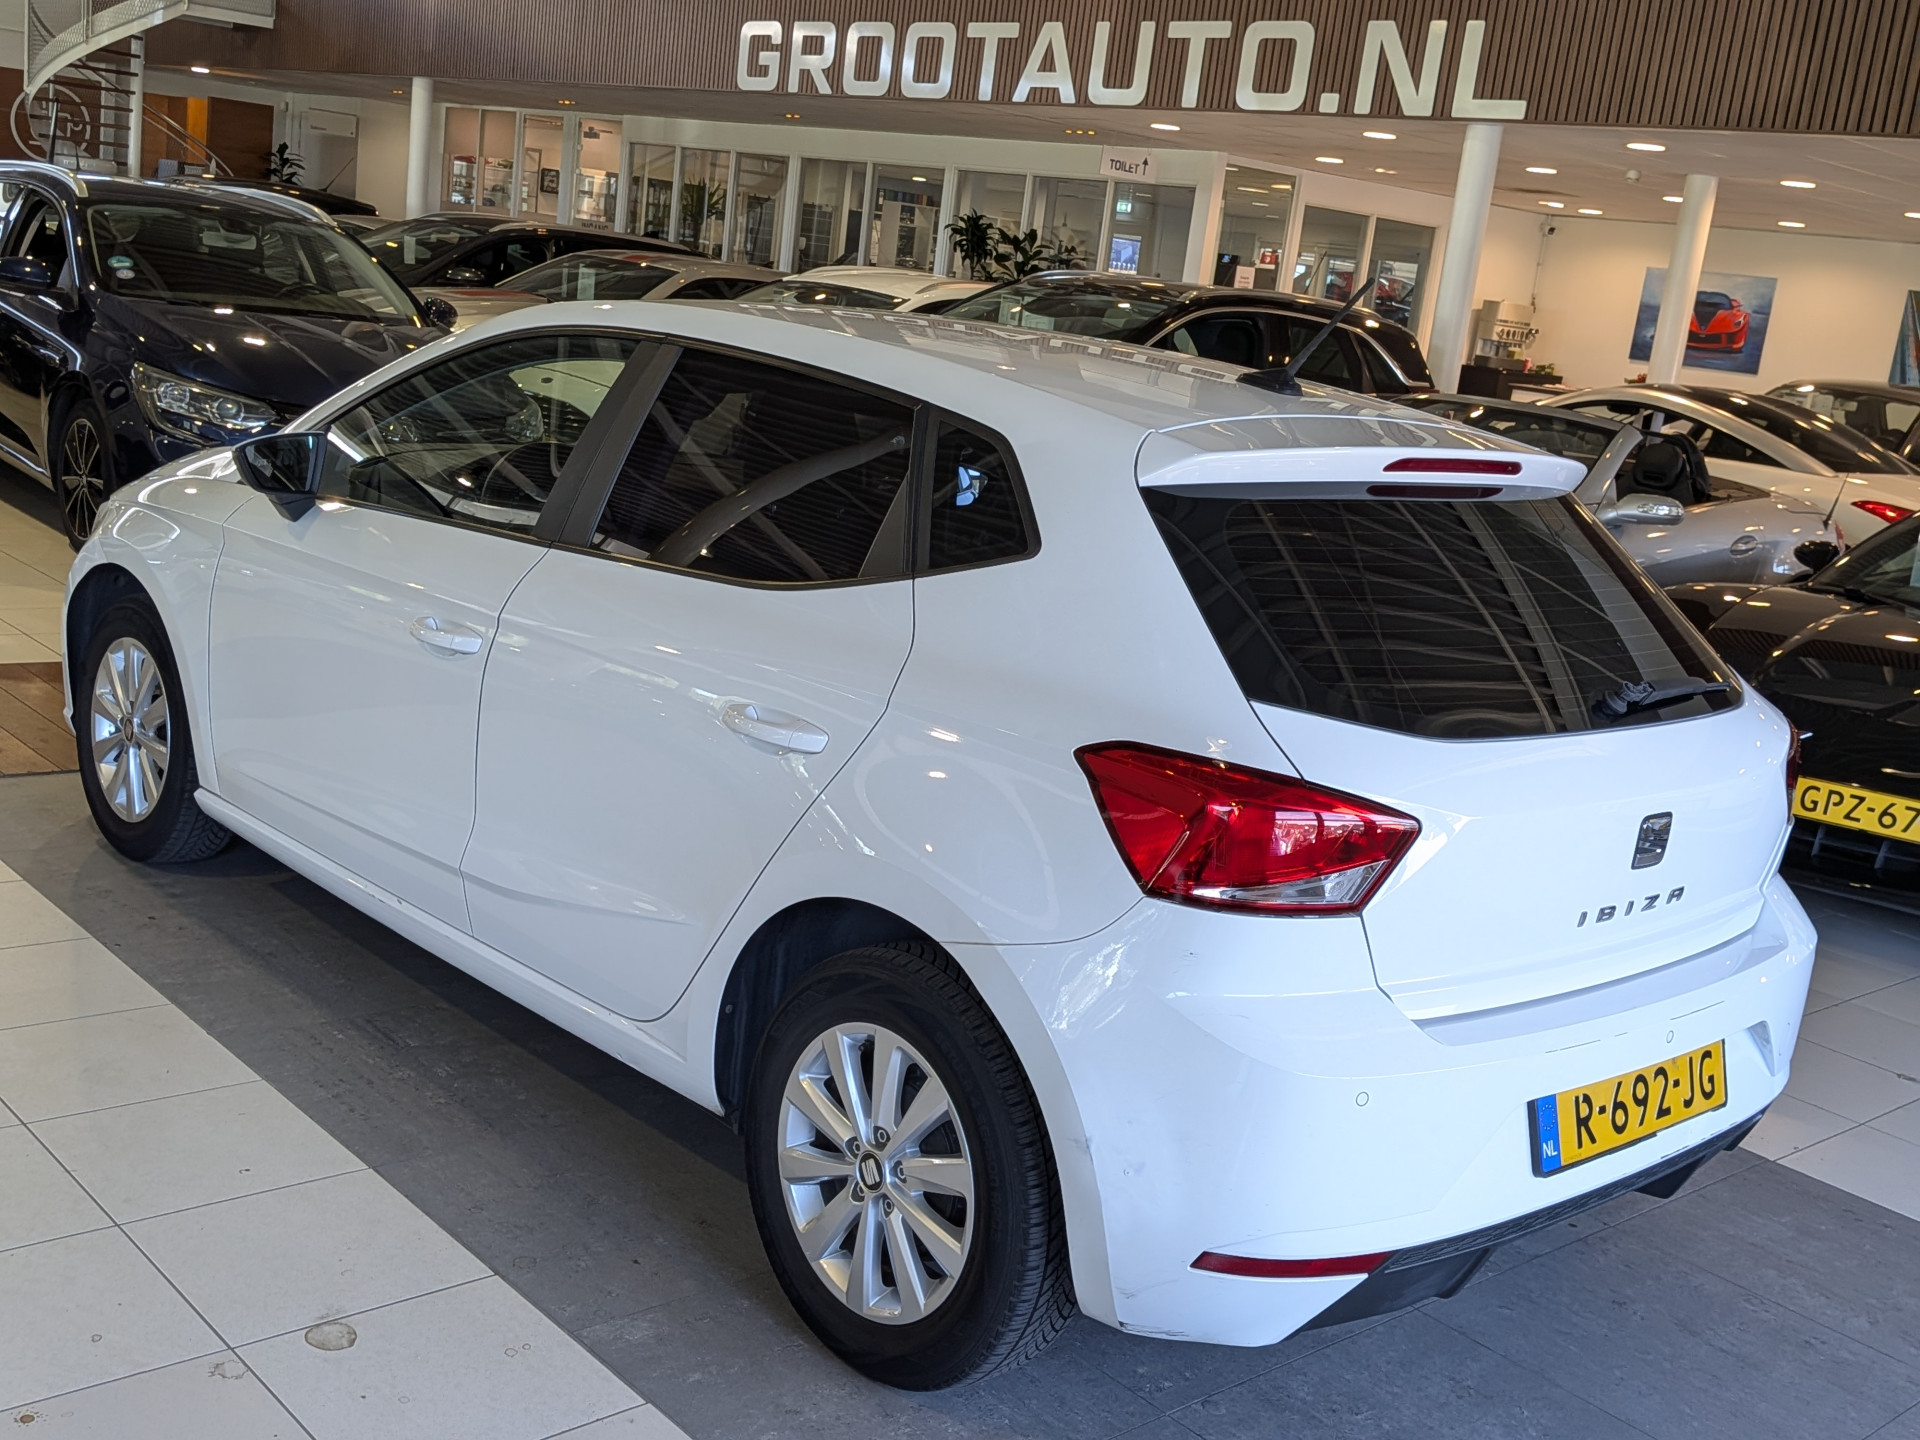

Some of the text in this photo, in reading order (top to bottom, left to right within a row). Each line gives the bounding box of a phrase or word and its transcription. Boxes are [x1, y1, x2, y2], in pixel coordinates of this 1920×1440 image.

[736, 20, 1527, 120] GROOTAUTO.NL
[1110, 158, 1140, 174] TOILET
[1800, 785, 1920, 833] GPZ-67
[1577, 886, 1685, 928] IBIZA
[1574, 1049, 1717, 1150] R-692-JG
[1542, 1139, 1558, 1159] NL
